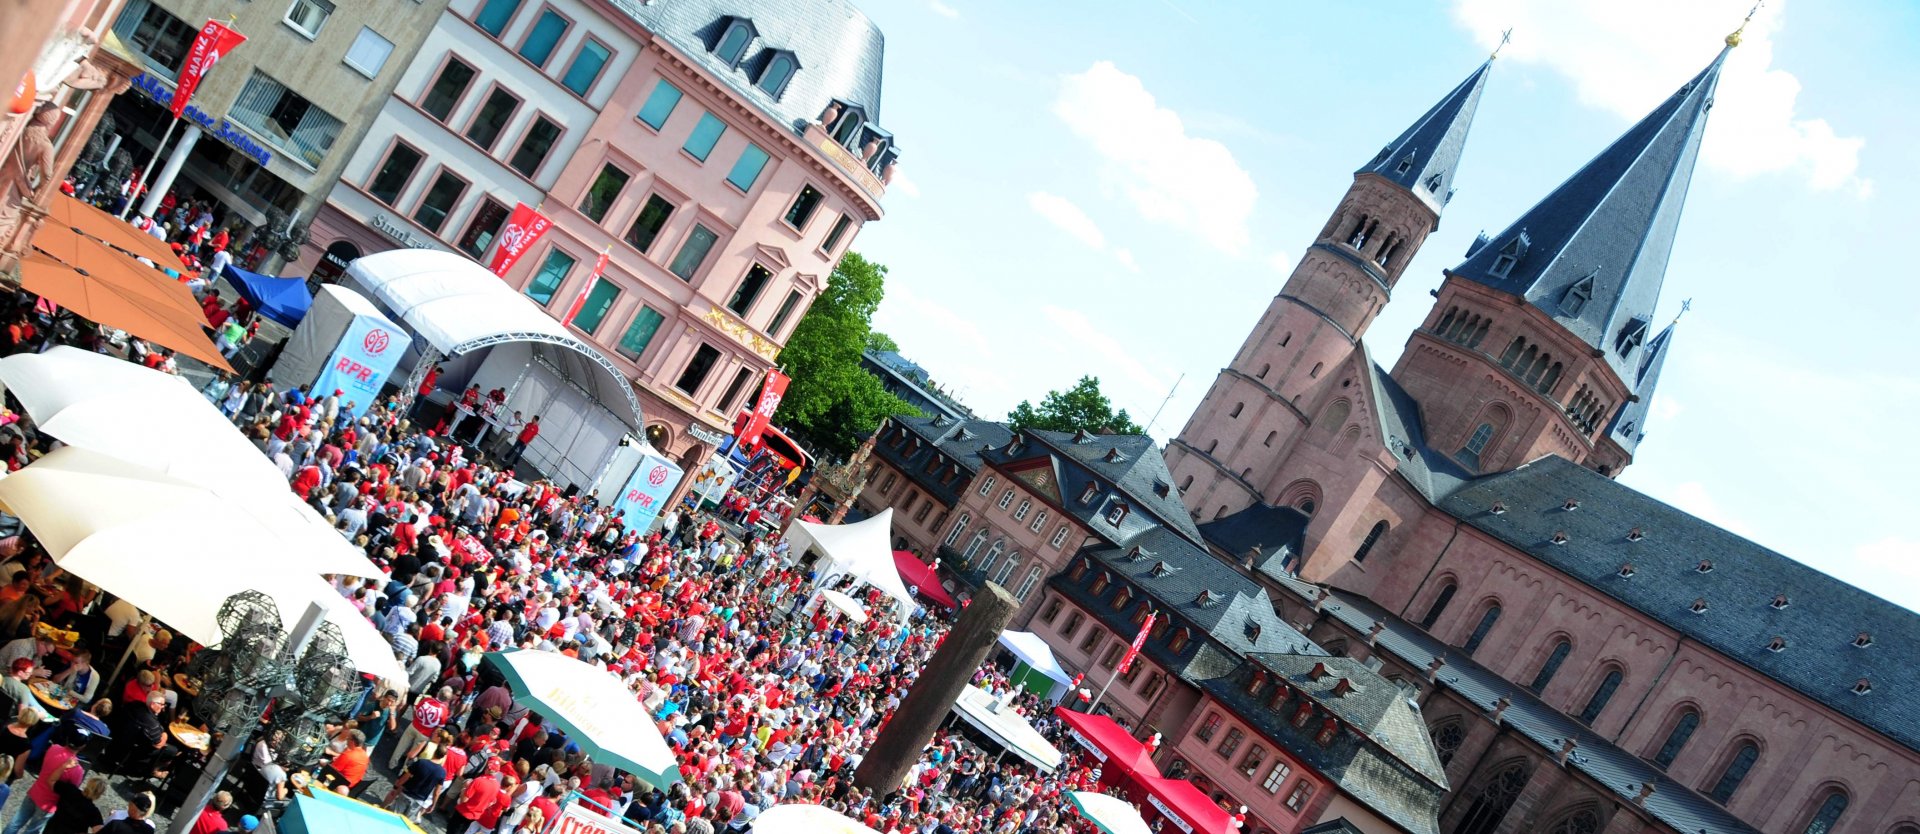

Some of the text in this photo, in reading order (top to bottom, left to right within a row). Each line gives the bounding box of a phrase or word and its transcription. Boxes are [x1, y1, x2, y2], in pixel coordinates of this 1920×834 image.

[188, 35, 209, 77] MAINZ
[204, 23, 217, 35] 05
[131, 72, 272, 167] Allgeeine Zeitung
